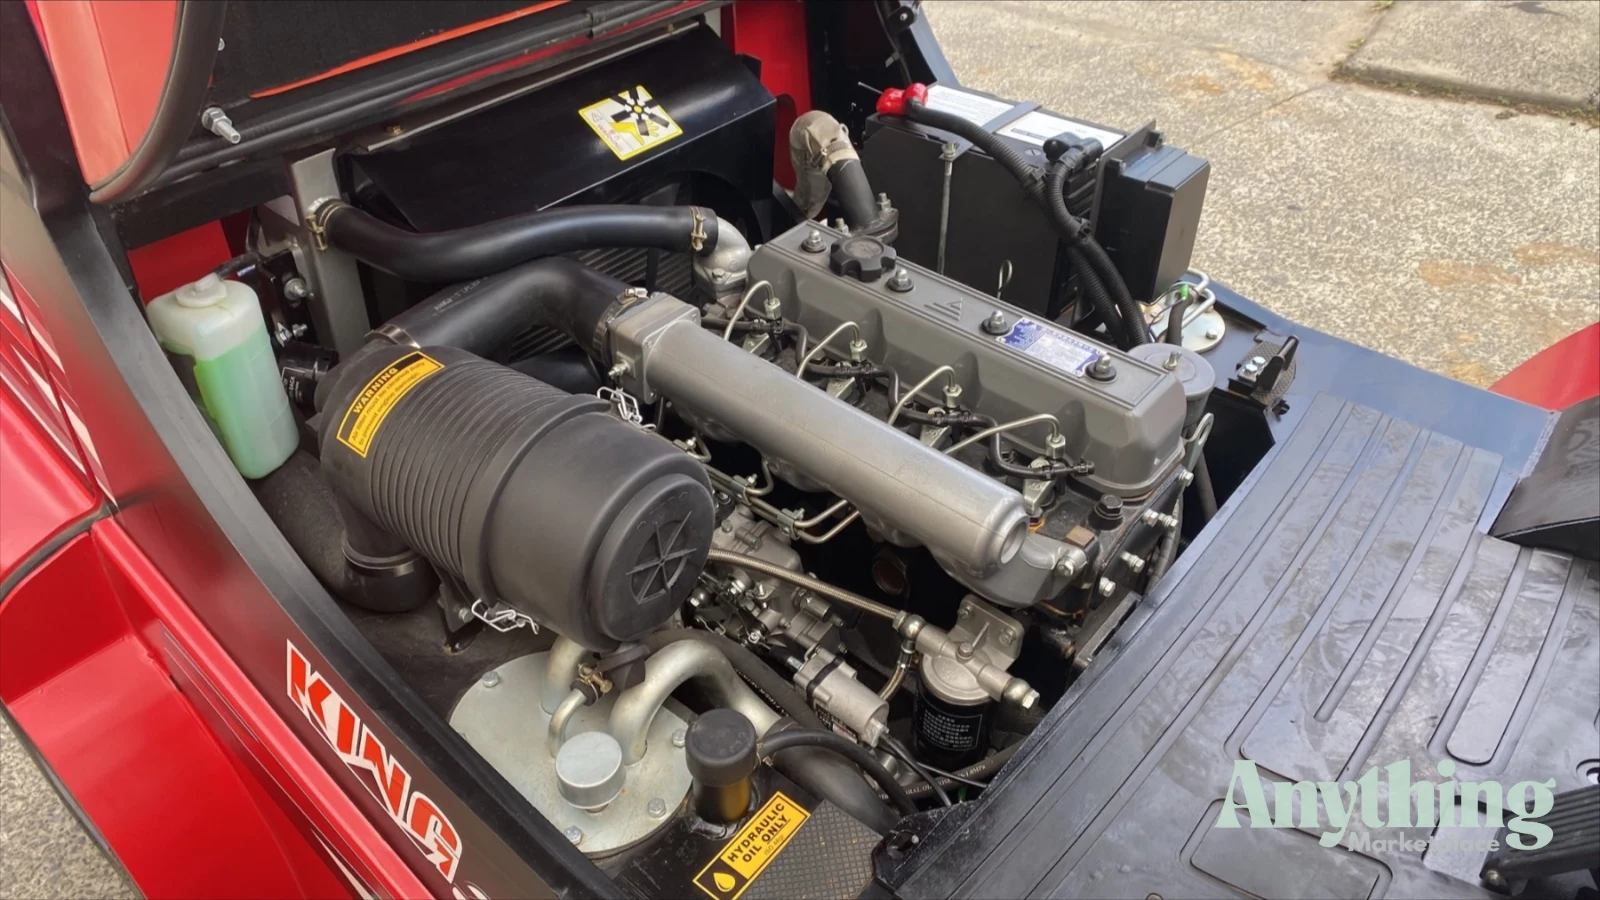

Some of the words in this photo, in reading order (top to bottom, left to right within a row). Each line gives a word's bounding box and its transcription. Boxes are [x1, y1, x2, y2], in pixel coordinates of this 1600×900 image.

[353, 367, 399, 414] WARNING
[366, 400, 378, 414] must
[379, 389, 387, 398] be
[363, 413, 378, 438] prevent
[377, 392, 395, 411] engine
[287, 639, 462, 884] KING
[727, 803, 785, 862] HYDRAULIC
[742, 846, 763, 863] OIL
[761, 814, 789, 843] ONLY
